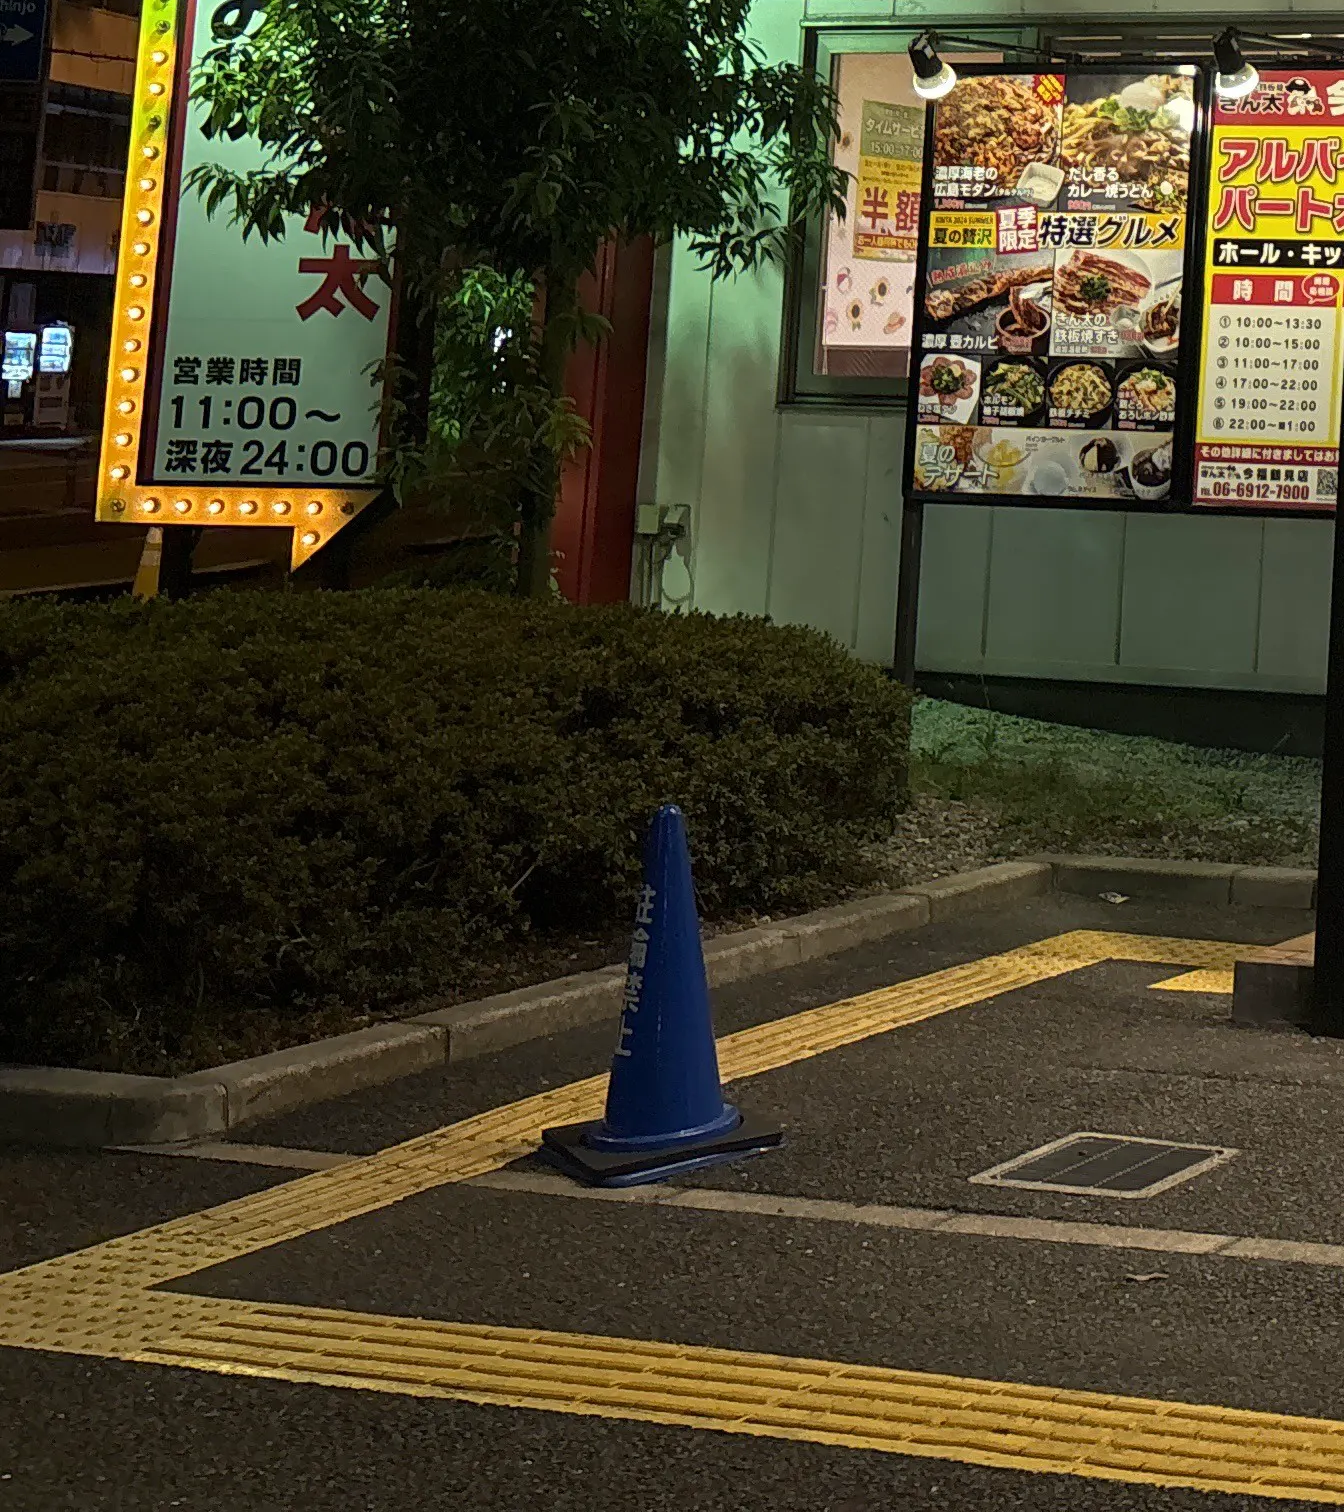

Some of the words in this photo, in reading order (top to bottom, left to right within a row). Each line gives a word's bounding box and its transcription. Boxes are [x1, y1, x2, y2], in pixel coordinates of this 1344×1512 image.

[1069, 166, 1120, 182] だし香る
[1067, 182, 1154, 198] カレー焼うどん
[999, 207, 1038, 229] 夏季
[998, 228, 1038, 251] 限定
[1037, 215, 1180, 248] 特選グルメ
[1232, 279, 1295, 303] 時間
[1055, 313, 1107, 327] きん太の
[173, 355, 302, 387] 営業時間
[165, 439, 368, 481] 深夜24:00
[923, 464, 999, 487] デザート
[1212, 481, 1310, 501] 06-6912-7900
